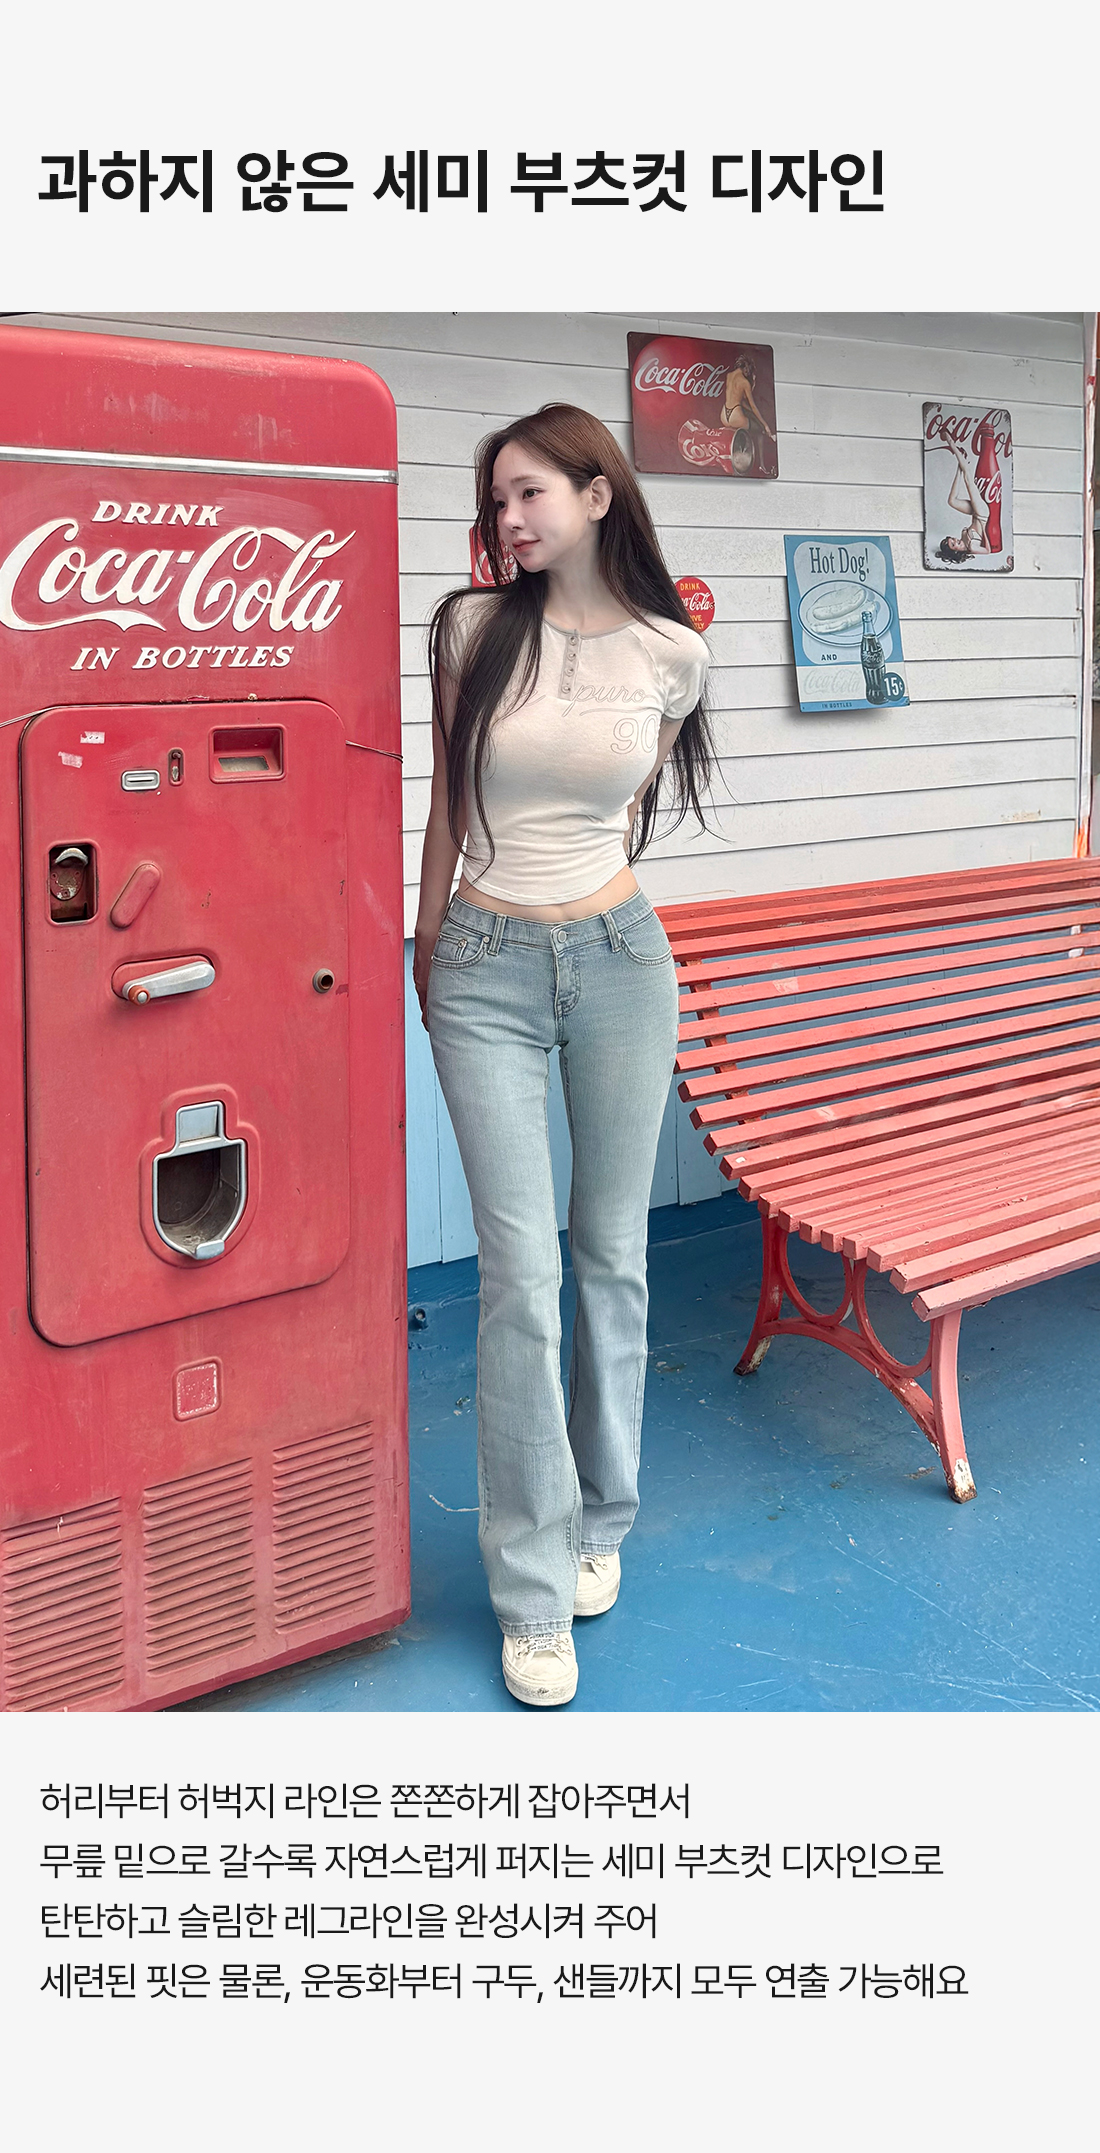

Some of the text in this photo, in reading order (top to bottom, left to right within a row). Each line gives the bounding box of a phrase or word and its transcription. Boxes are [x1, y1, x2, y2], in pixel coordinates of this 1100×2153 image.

[634, 357, 730, 398] Coca-Cola
[91, 500, 225, 527] DRINK
[0, 517, 356, 632] Coca-Cola
[809, 547, 870, 582] Hot Dog!
[680, 582, 701, 591] DRINK
[70, 646, 294, 670] IN BOTTLES
[803, 669, 862, 695] Coca-Cola
[562, 685, 658, 717] puro
[610, 714, 659, 754] 90
